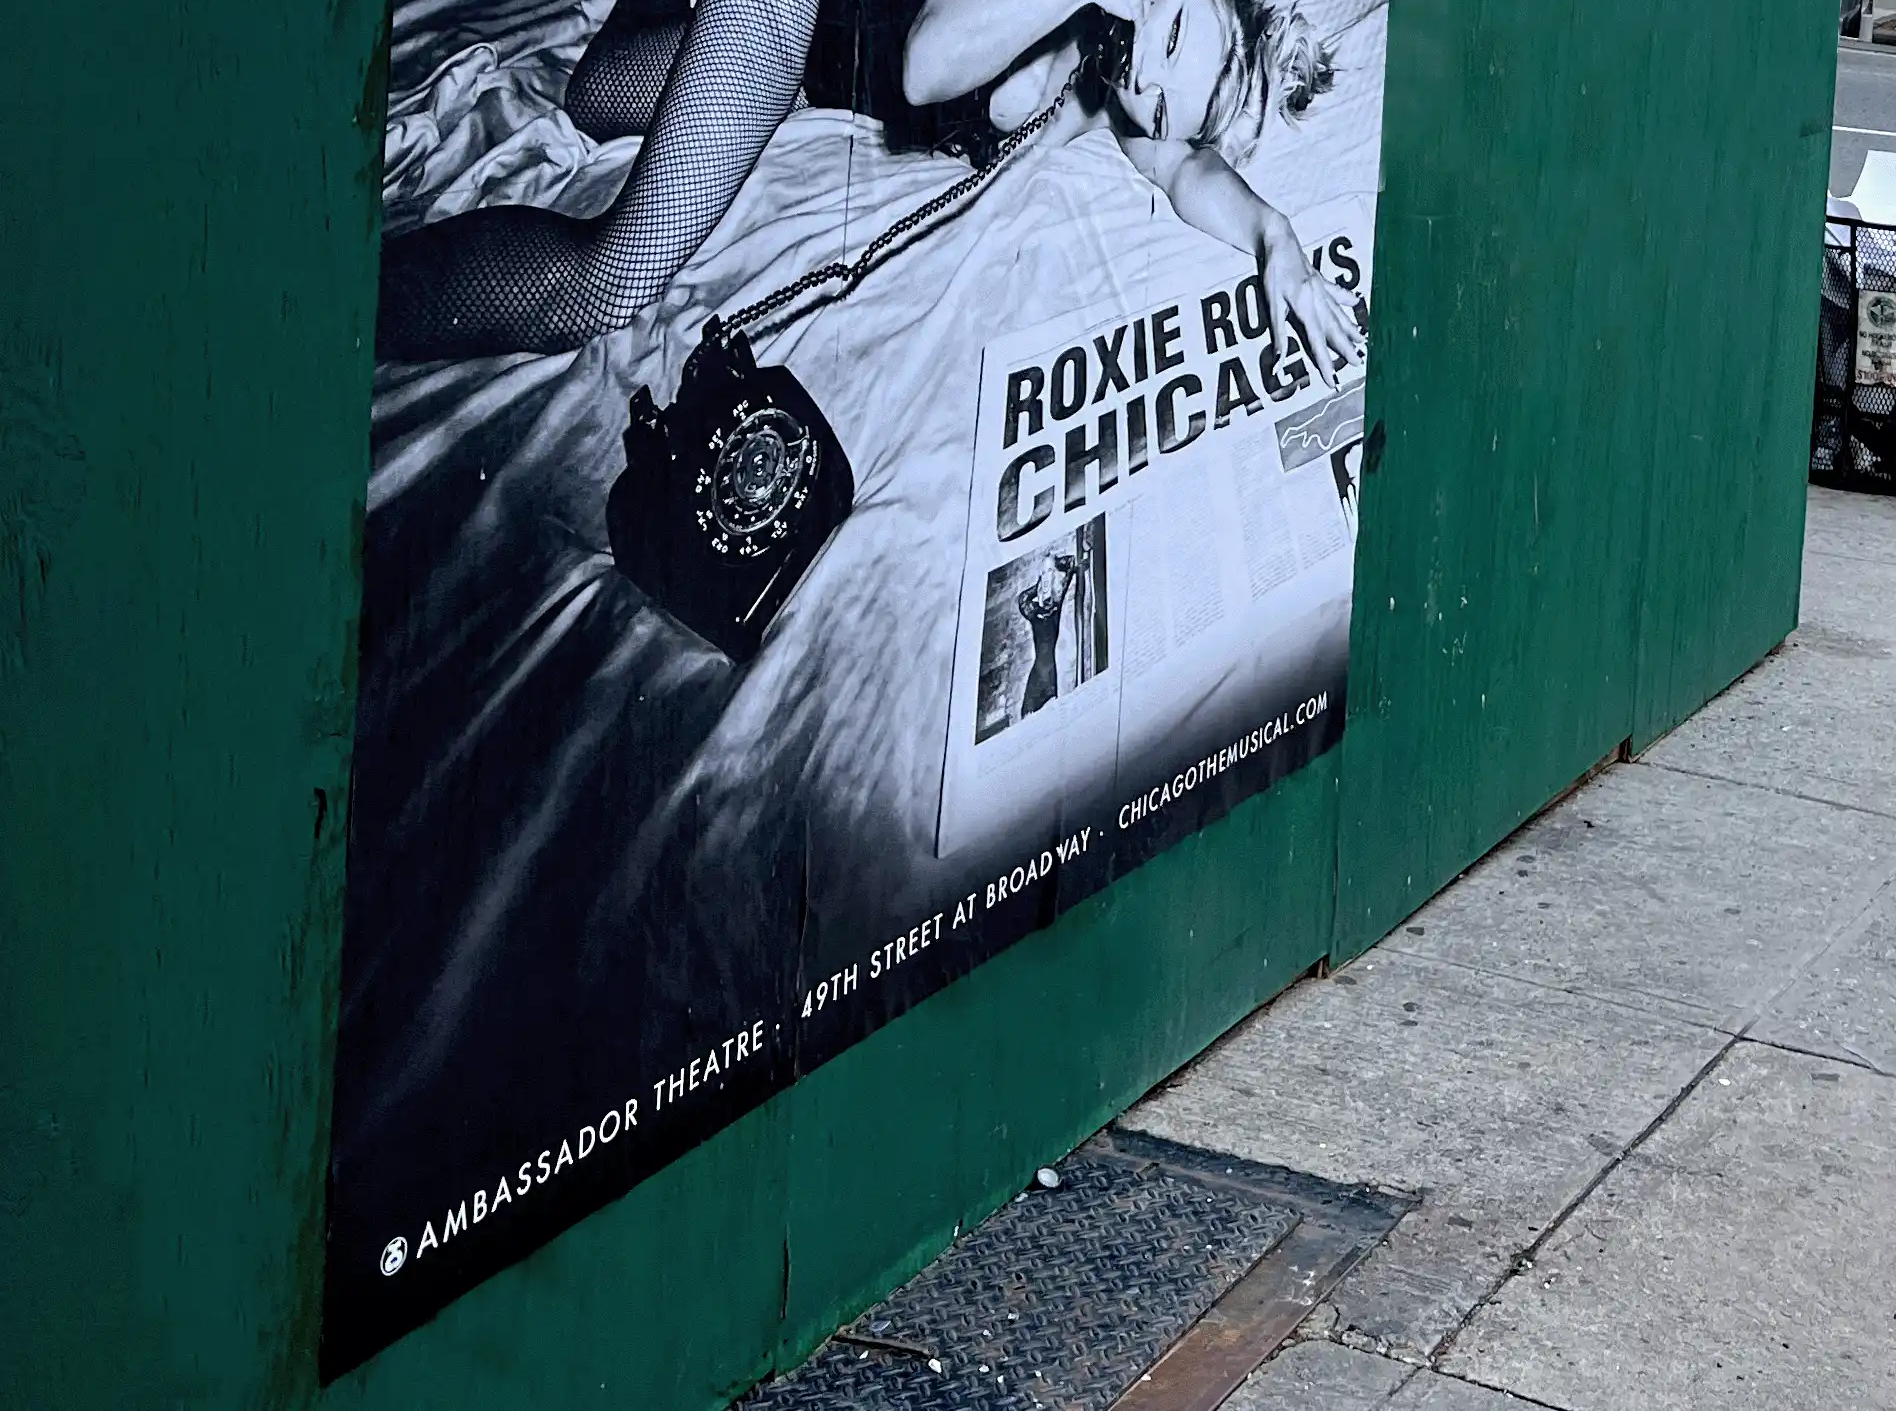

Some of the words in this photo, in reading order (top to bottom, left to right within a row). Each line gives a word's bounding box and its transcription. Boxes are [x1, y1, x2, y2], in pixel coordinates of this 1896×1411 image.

[997, 295, 1368, 543] CHICAG
[1002, 305, 1185, 450] ROXIE
[416, 1098, 638, 1259] AMBASSADOR
[654, 1019, 764, 1111] THEATRE
[801, 963, 858, 1018] 49TH
[870, 913, 944, 979] STREET
[952, 893, 977, 930] AT
[1118, 690, 1328, 830] CHICAGOTHEMUSICAL.COM
